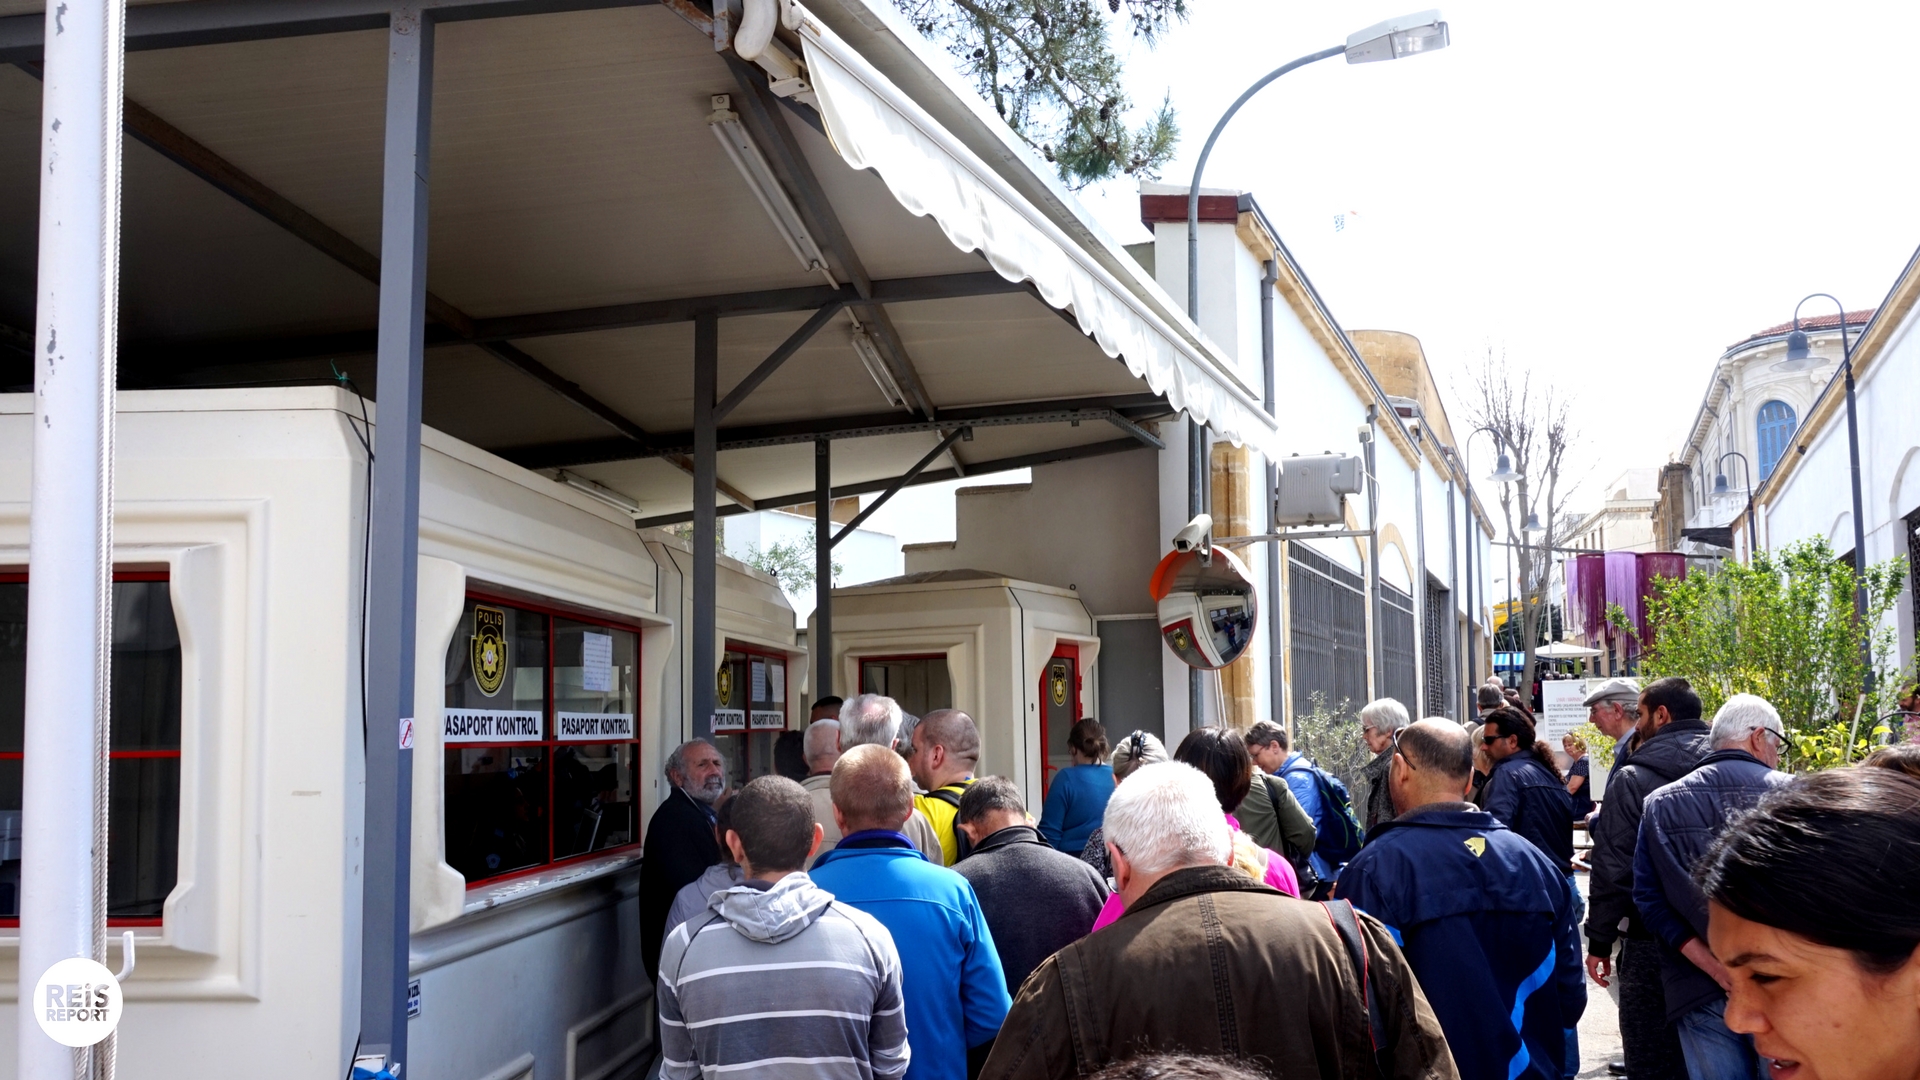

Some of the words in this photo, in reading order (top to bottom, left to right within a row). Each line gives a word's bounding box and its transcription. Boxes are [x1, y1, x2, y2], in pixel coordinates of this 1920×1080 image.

[444, 715, 493, 736] ASAPORT
[496, 716, 538, 735] KONTROL
[561, 717, 599, 735] PASAPORT
[600, 717, 630, 734] KONTROL
[726, 713, 743, 725] KONTROL
[752, 714, 768, 725] PASAPORT
